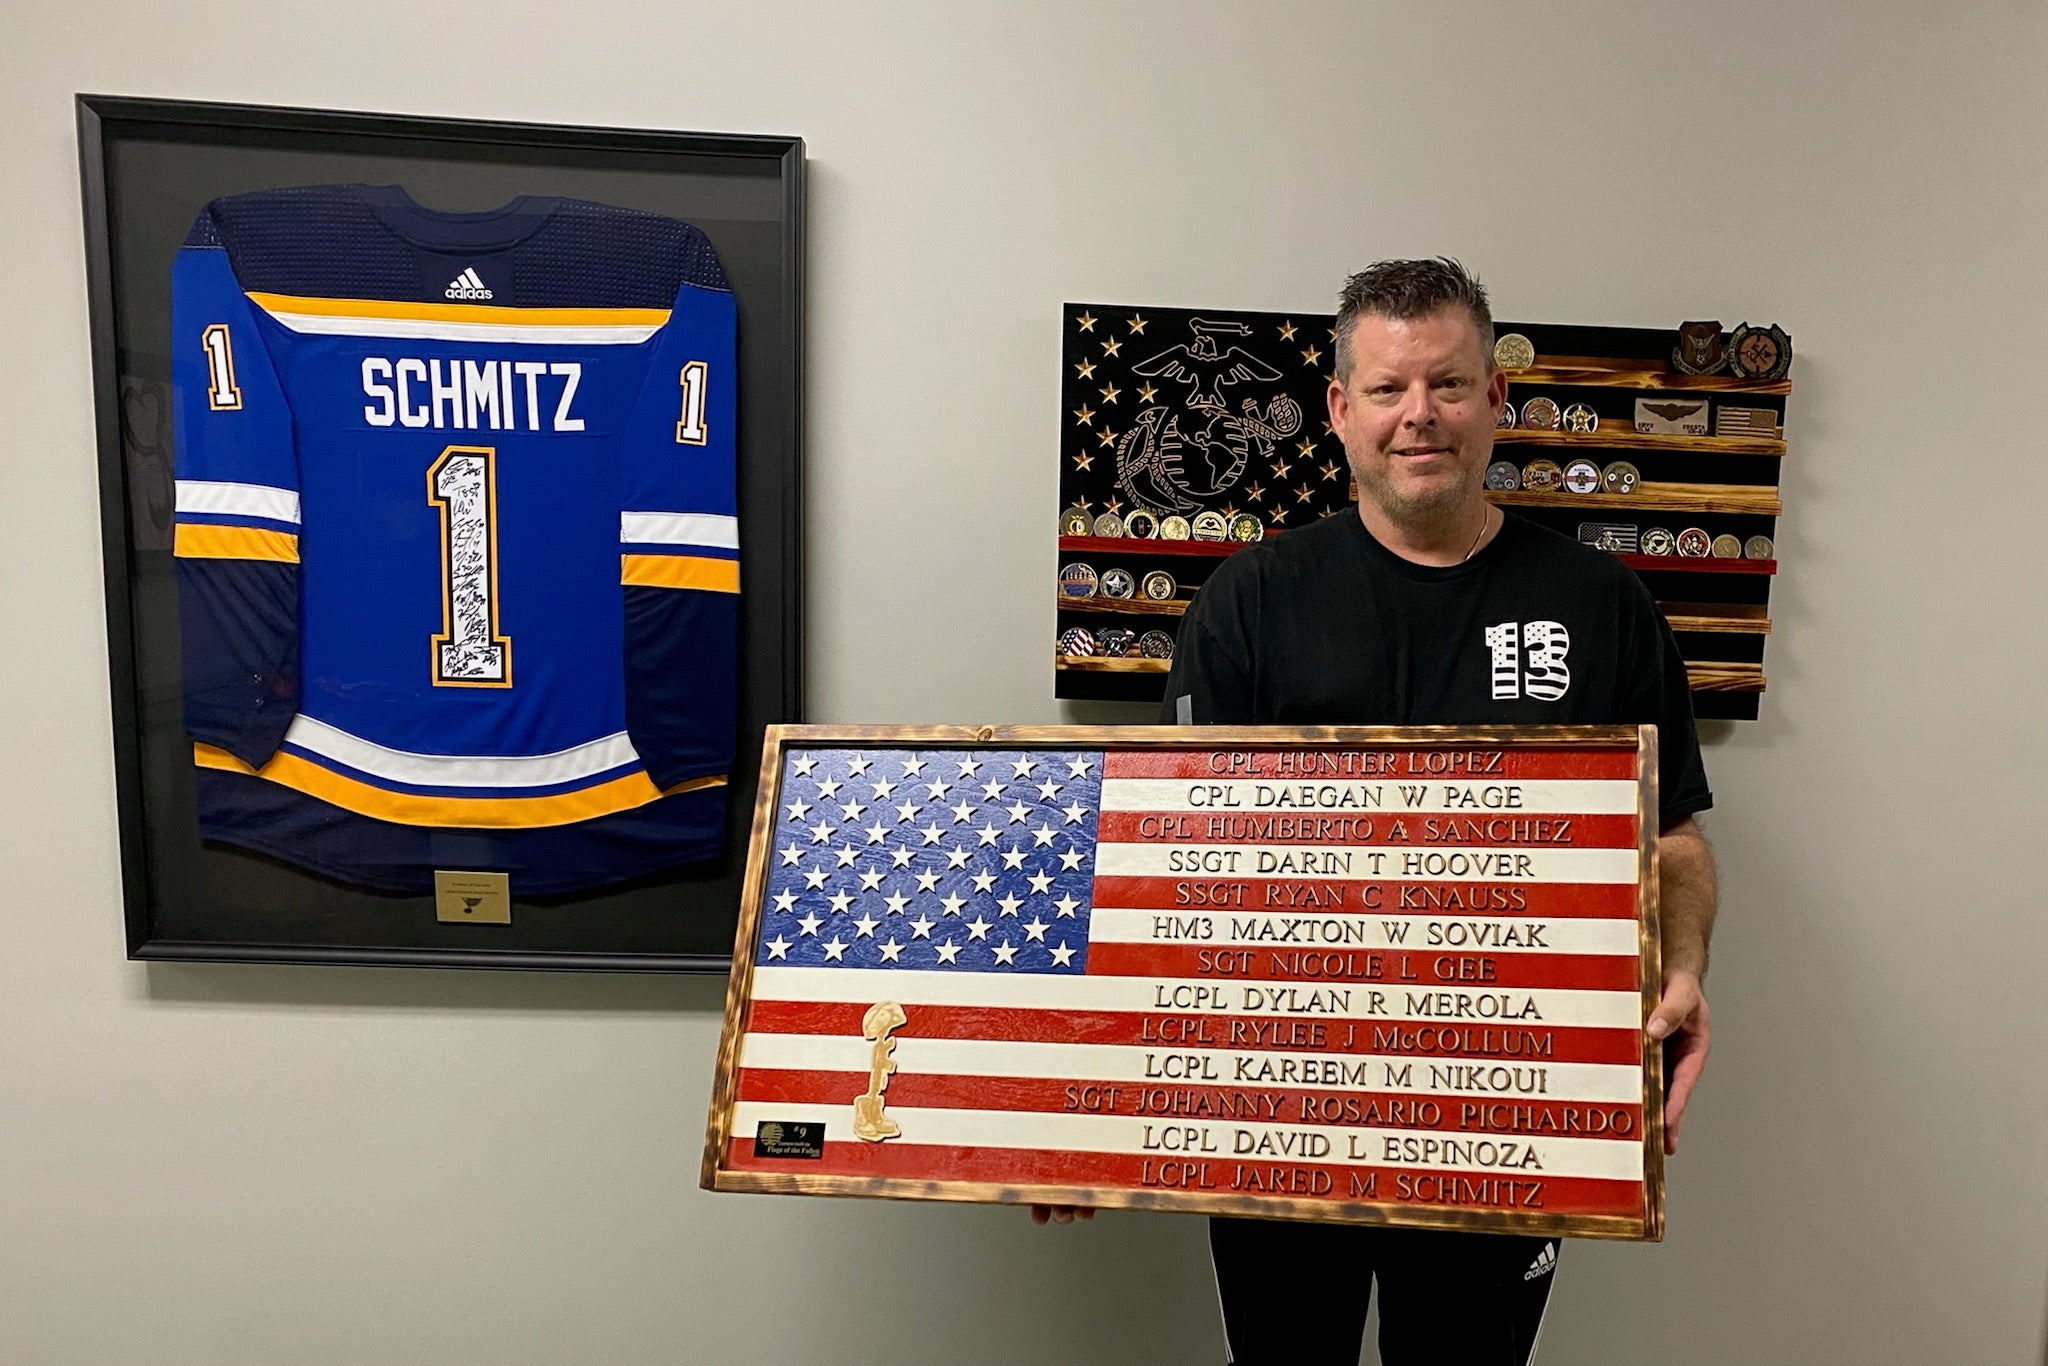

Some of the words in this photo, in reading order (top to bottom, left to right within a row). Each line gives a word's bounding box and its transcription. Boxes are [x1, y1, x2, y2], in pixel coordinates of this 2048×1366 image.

[444, 287, 493, 300] adidas
[201, 324, 242, 410] 1
[362, 358, 585, 431] SCHMITZ
[676, 361, 708, 445] 1
[426, 445, 512, 688] 1
[1485, 621, 1570, 701] 13
[1209, 751, 1263, 774] CPL
[1278, 752, 1396, 775] HUNTER
[1407, 752, 1503, 775] LOPEZ
[1187, 786, 1241, 807] CPL
[1254, 786, 1384, 808] DAEGAN
[1400, 786, 1428, 808] W
[1443, 786, 1523, 809] PAGE
[1139, 817, 1193, 839] CPL
[1207, 818, 1373, 841] HUMBERTO
[1387, 820, 1407, 842] A
[1425, 820, 1571, 843] SANCHEZ
[1169, 851, 1243, 873] SSGT
[1256, 852, 1352, 874] DARIN
[1368, 853, 1387, 874] T
[1401, 853, 1535, 877] HOOVER
[1175, 883, 1250, 906] SSGT
[1264, 884, 1348, 908] RYAN
[1363, 887, 1382, 909] C
[1398, 887, 1527, 911] KNAUSS
[1152, 916, 1213, 940] HM3
[1231, 918, 1365, 944] MAXTON
[1381, 921, 1409, 945] W
[1427, 922, 1549, 948] SOVIAK
[1198, 951, 1255, 975] SGT
[1270, 953, 1382, 979] NICOLE
[1401, 956, 1418, 980] L
[1434, 957, 1497, 982] GEE
[1154, 985, 1227, 1010] LCPL
[1242, 988, 1350, 1013] DYLAN
[1367, 990, 1388, 1015] R
[1404, 992, 1543, 1020] MEROLA
[1141, 1018, 1215, 1044] LCPL
[1229, 1021, 1327, 1049] RYLEE
[1342, 1025, 1356, 1050] J
[1373, 1026, 1553, 1056] McCOLLUM
[1145, 1054, 1218, 1080] LCPL
[1234, 1057, 1366, 1085] KAREEM
[1384, 1062, 1413, 1087] M
[1429, 1064, 1548, 1094] NIKOUI
[1065, 1086, 1121, 1112] SGT
[1136, 1088, 1285, 1120] JOHANNY
[1300, 1094, 1441, 1126] ROSARIO
[1460, 1103, 1633, 1134] PICHARDO
[767, 1146, 782, 1154] Flags
[801, 1147, 820, 1155] Fallen
[1142, 1125, 1217, 1153] LCPL
[1233, 1129, 1330, 1158] DAVID
[1347, 1135, 1366, 1160] L
[1382, 1137, 1543, 1170] ESPINOZA
[1141, 1161, 1216, 1189] LCPL
[1230, 1165, 1331, 1194] JARED
[1350, 1172, 1377, 1197] M
[1396, 1174, 1544, 1209] SCHMITZ
